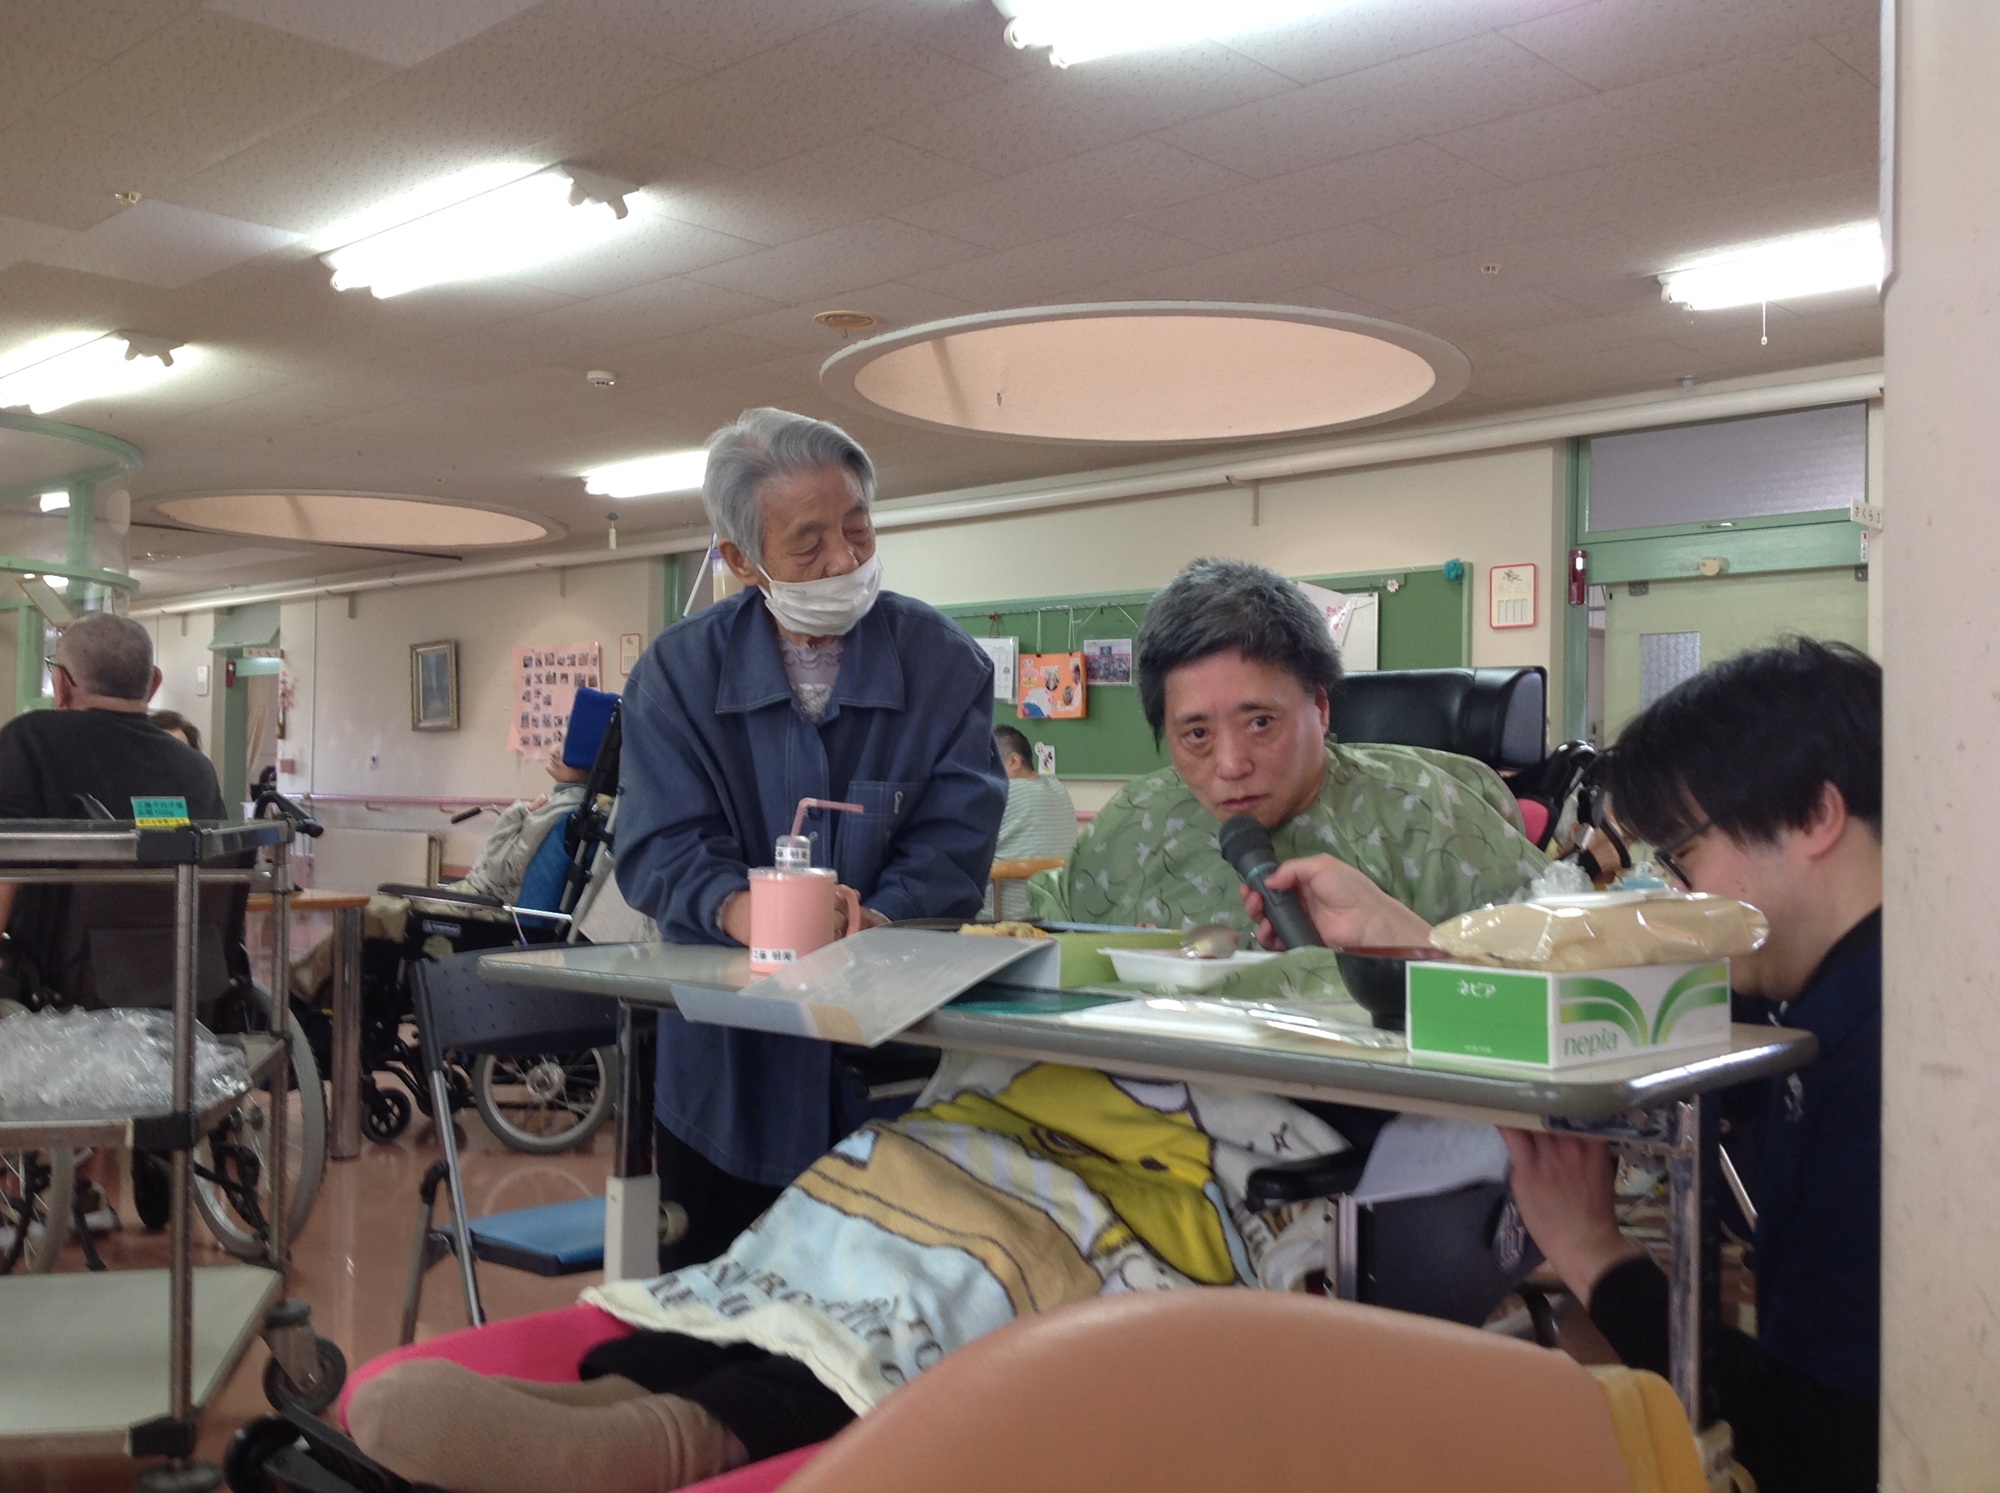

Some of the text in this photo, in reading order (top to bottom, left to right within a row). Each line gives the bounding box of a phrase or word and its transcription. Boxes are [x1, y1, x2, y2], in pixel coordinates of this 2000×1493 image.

[1456, 979, 1497, 999] ネピア
[1563, 1027, 1618, 1058] nepia
